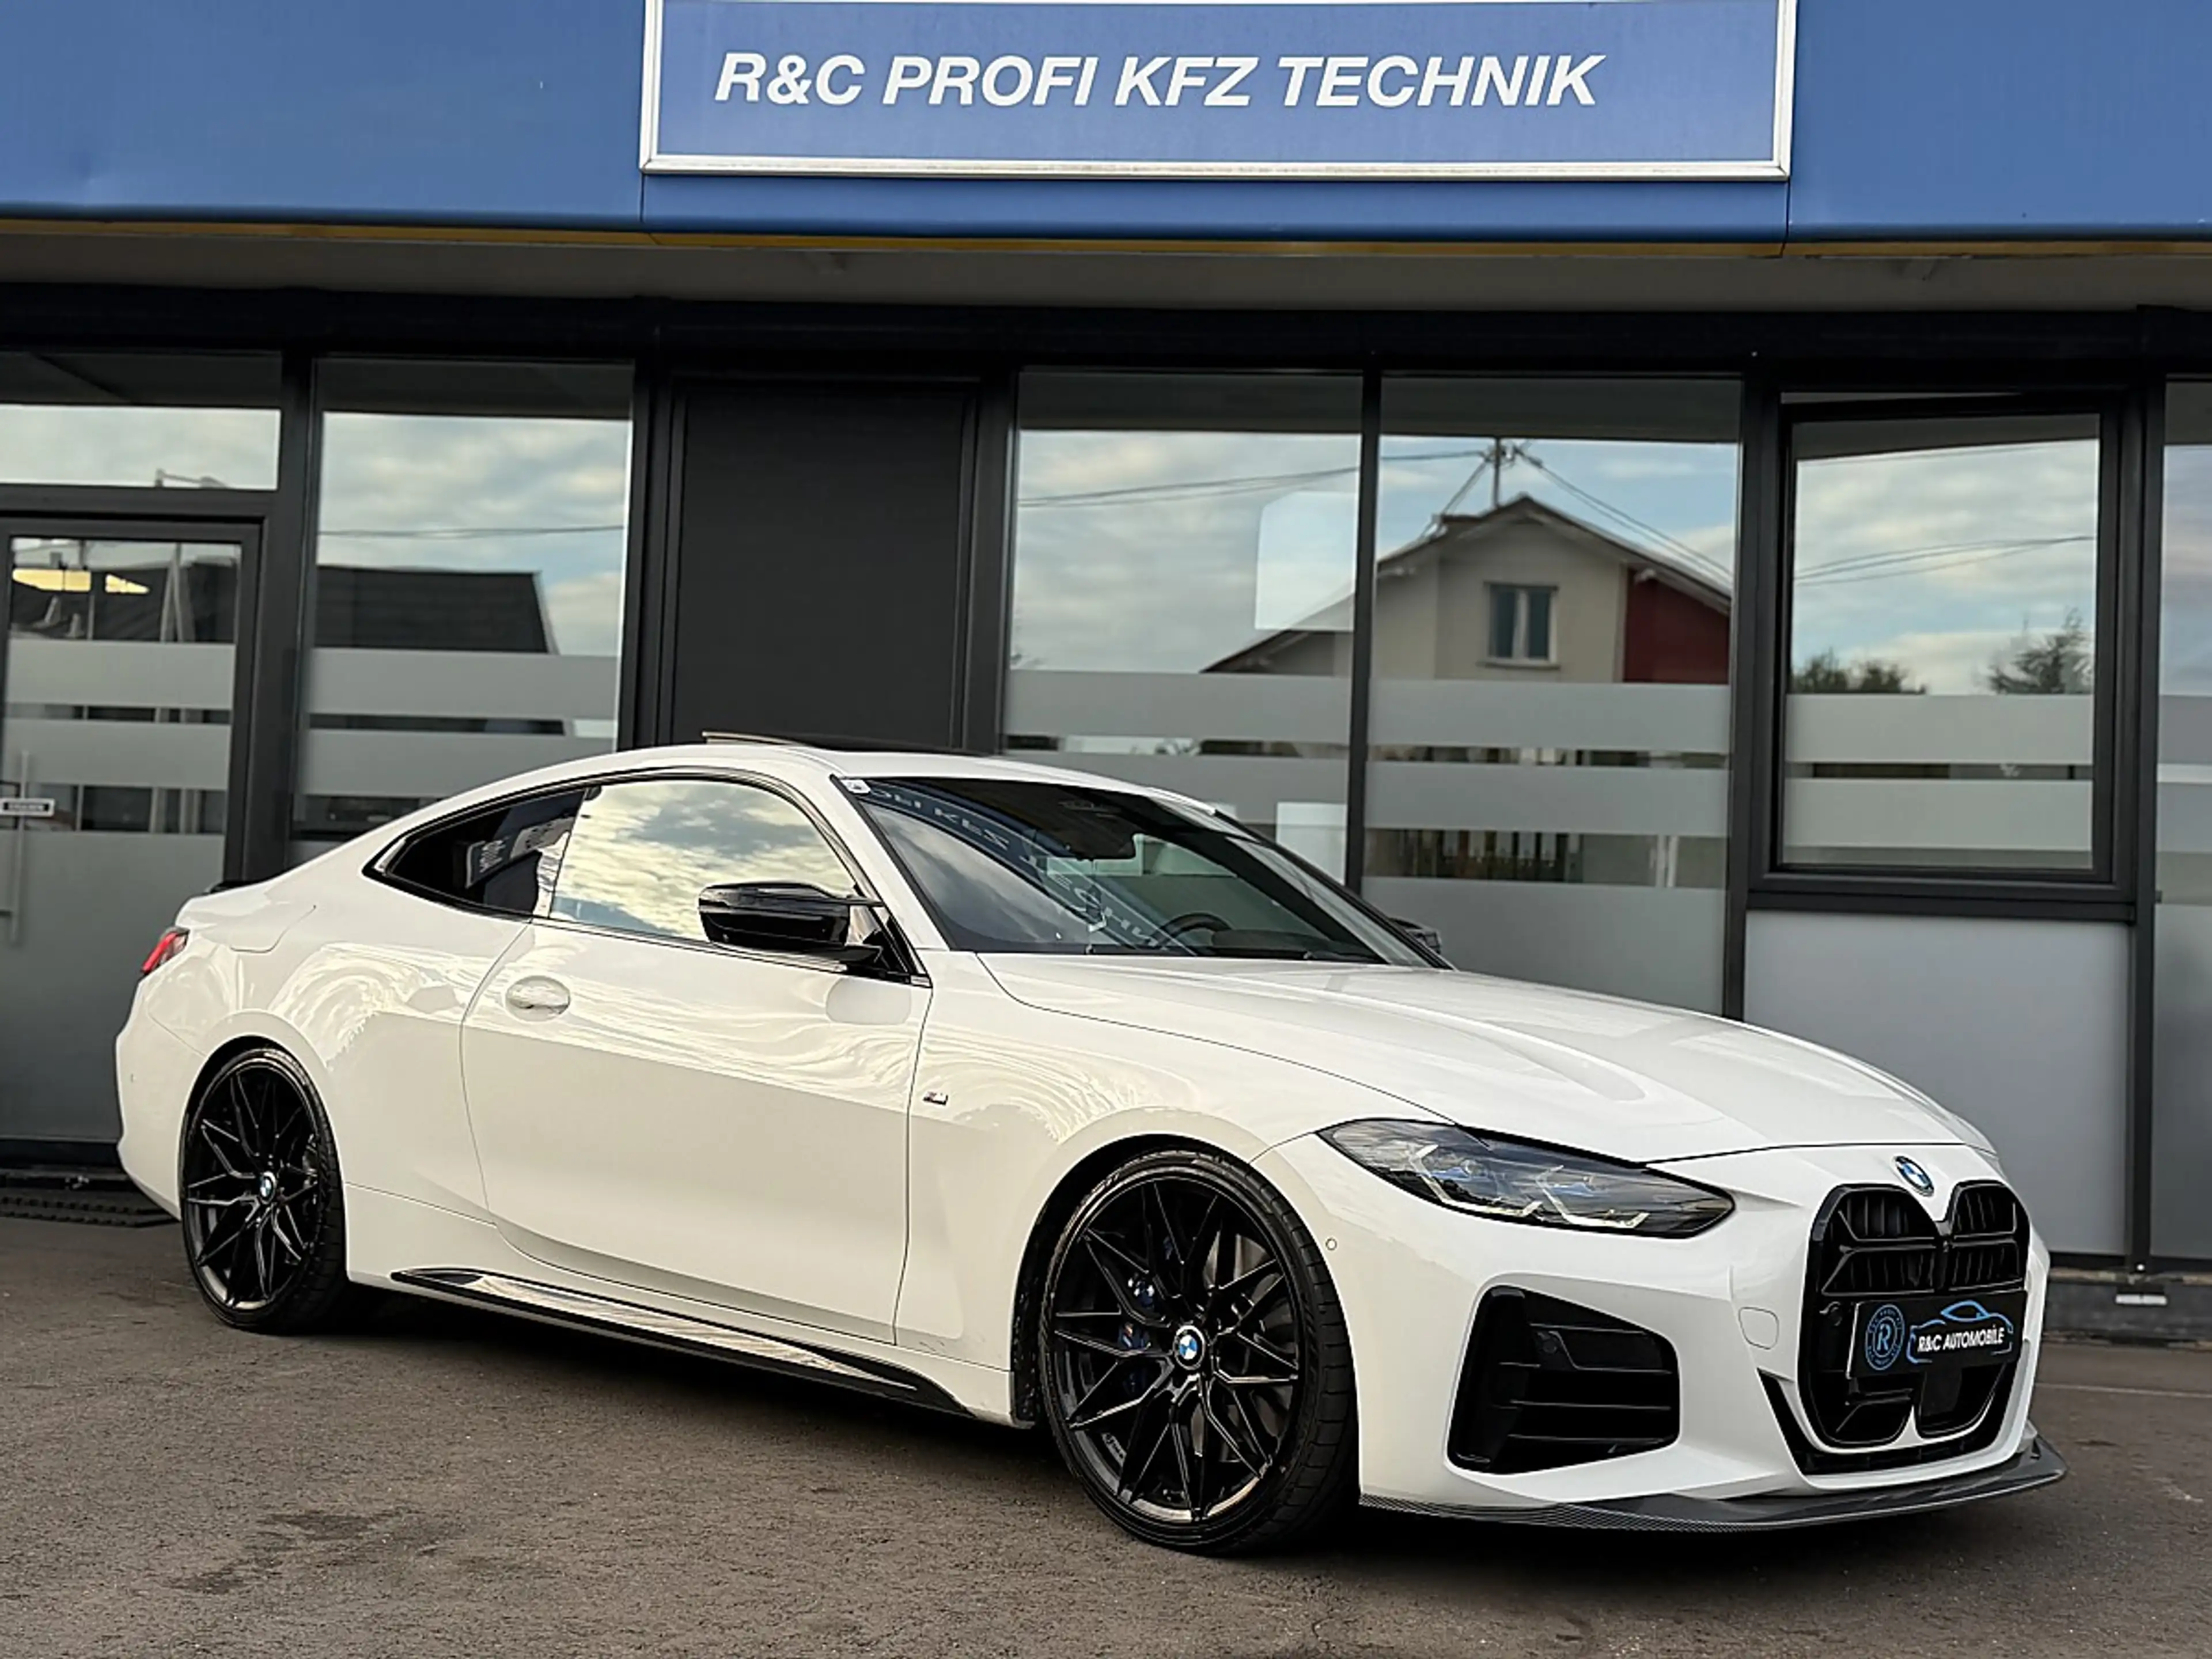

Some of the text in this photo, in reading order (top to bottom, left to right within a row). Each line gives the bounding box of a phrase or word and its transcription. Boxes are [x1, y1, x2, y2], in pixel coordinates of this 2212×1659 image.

[715, 52, 1607, 108] R&C PROFI KFZ TECHNIK
[1917, 1334, 1942, 1352] R&C
